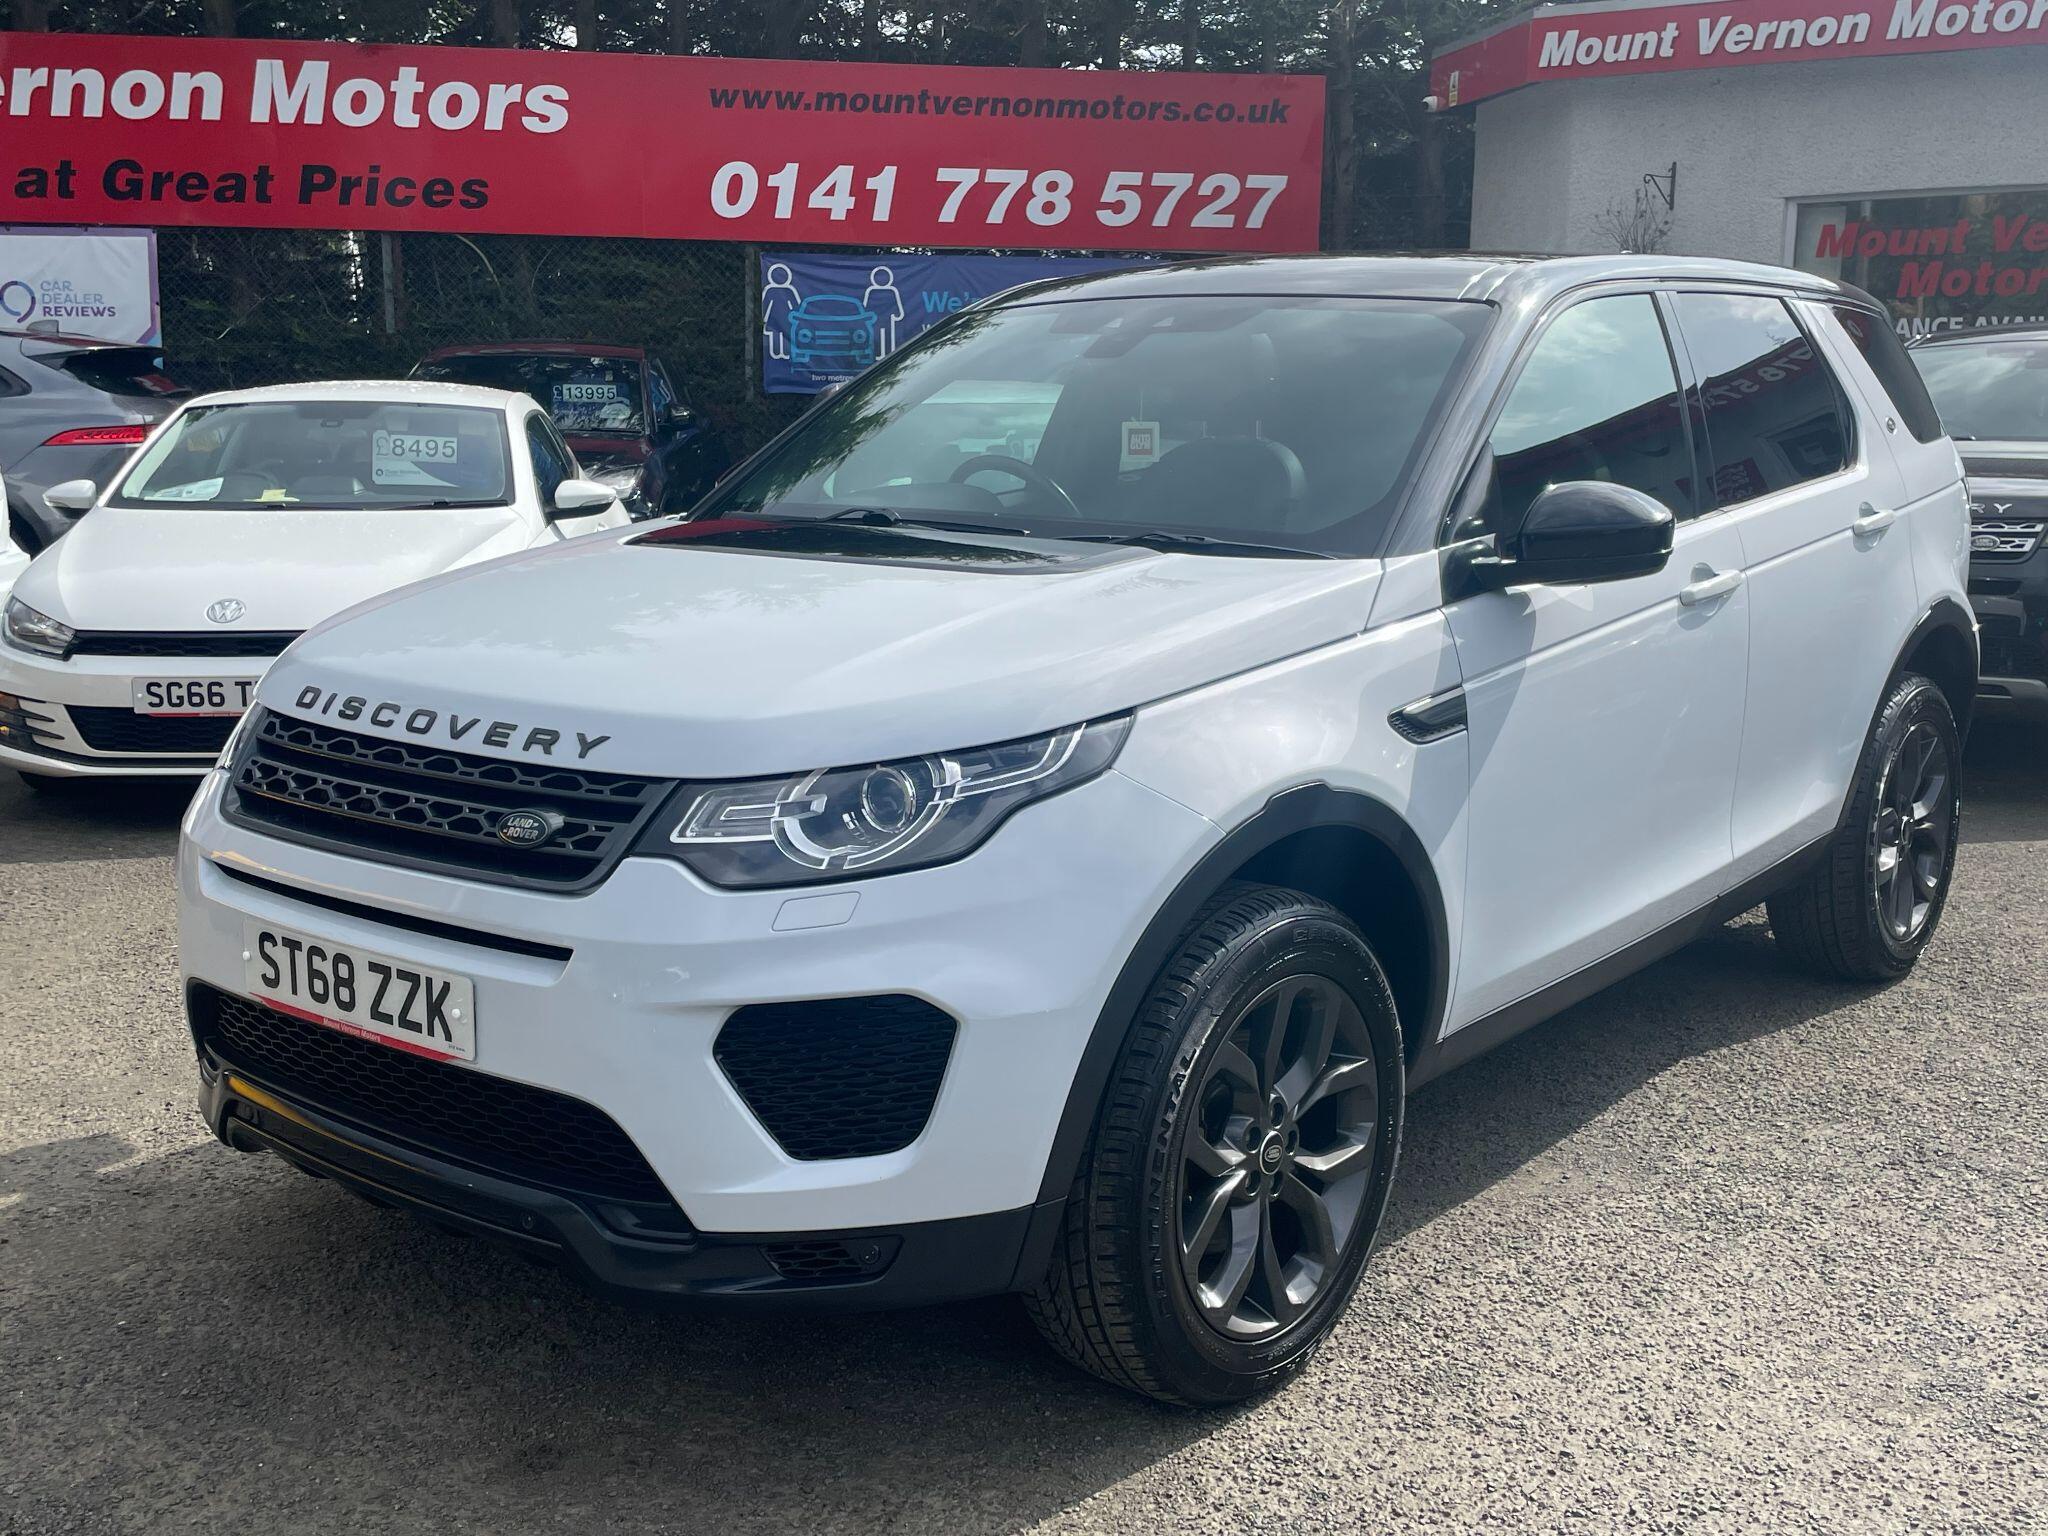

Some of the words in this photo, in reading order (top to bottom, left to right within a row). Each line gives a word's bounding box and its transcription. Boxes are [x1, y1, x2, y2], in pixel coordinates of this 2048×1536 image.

[1538, 22, 1679, 68] Mount
[1698, 12, 1871, 55] Vernon
[0, 67, 224, 121] rnon
[250, 58, 570, 134] Motors
[709, 88, 1291, 124] www.mountvernonmotors.co.uk
[14, 159, 80, 200] at
[102, 158, 275, 204] Great
[298, 164, 490, 210] Prices
[710, 161, 899, 222] 0141
[936, 167, 1074, 227] 778
[1096, 171, 1289, 229] 5727
[1815, 218, 1972, 258] Mount
[40, 280, 73, 292] CAR
[41, 293, 105, 305] DEALER
[43, 306, 117, 318] REVIEWS
[552, 384, 617, 400] £13995
[376, 436, 457, 458] £8495
[145, 681, 226, 708] SG66
[234, 681, 260, 708] T
[295, 685, 612, 759] DISCOVERY
[505, 826, 539, 841] ROVER
[507, 816, 536, 829] LAND
[258, 930, 357, 1013] ST68
[367, 960, 453, 1043] ZZK
[360, 1028, 382, 1043] Motors
